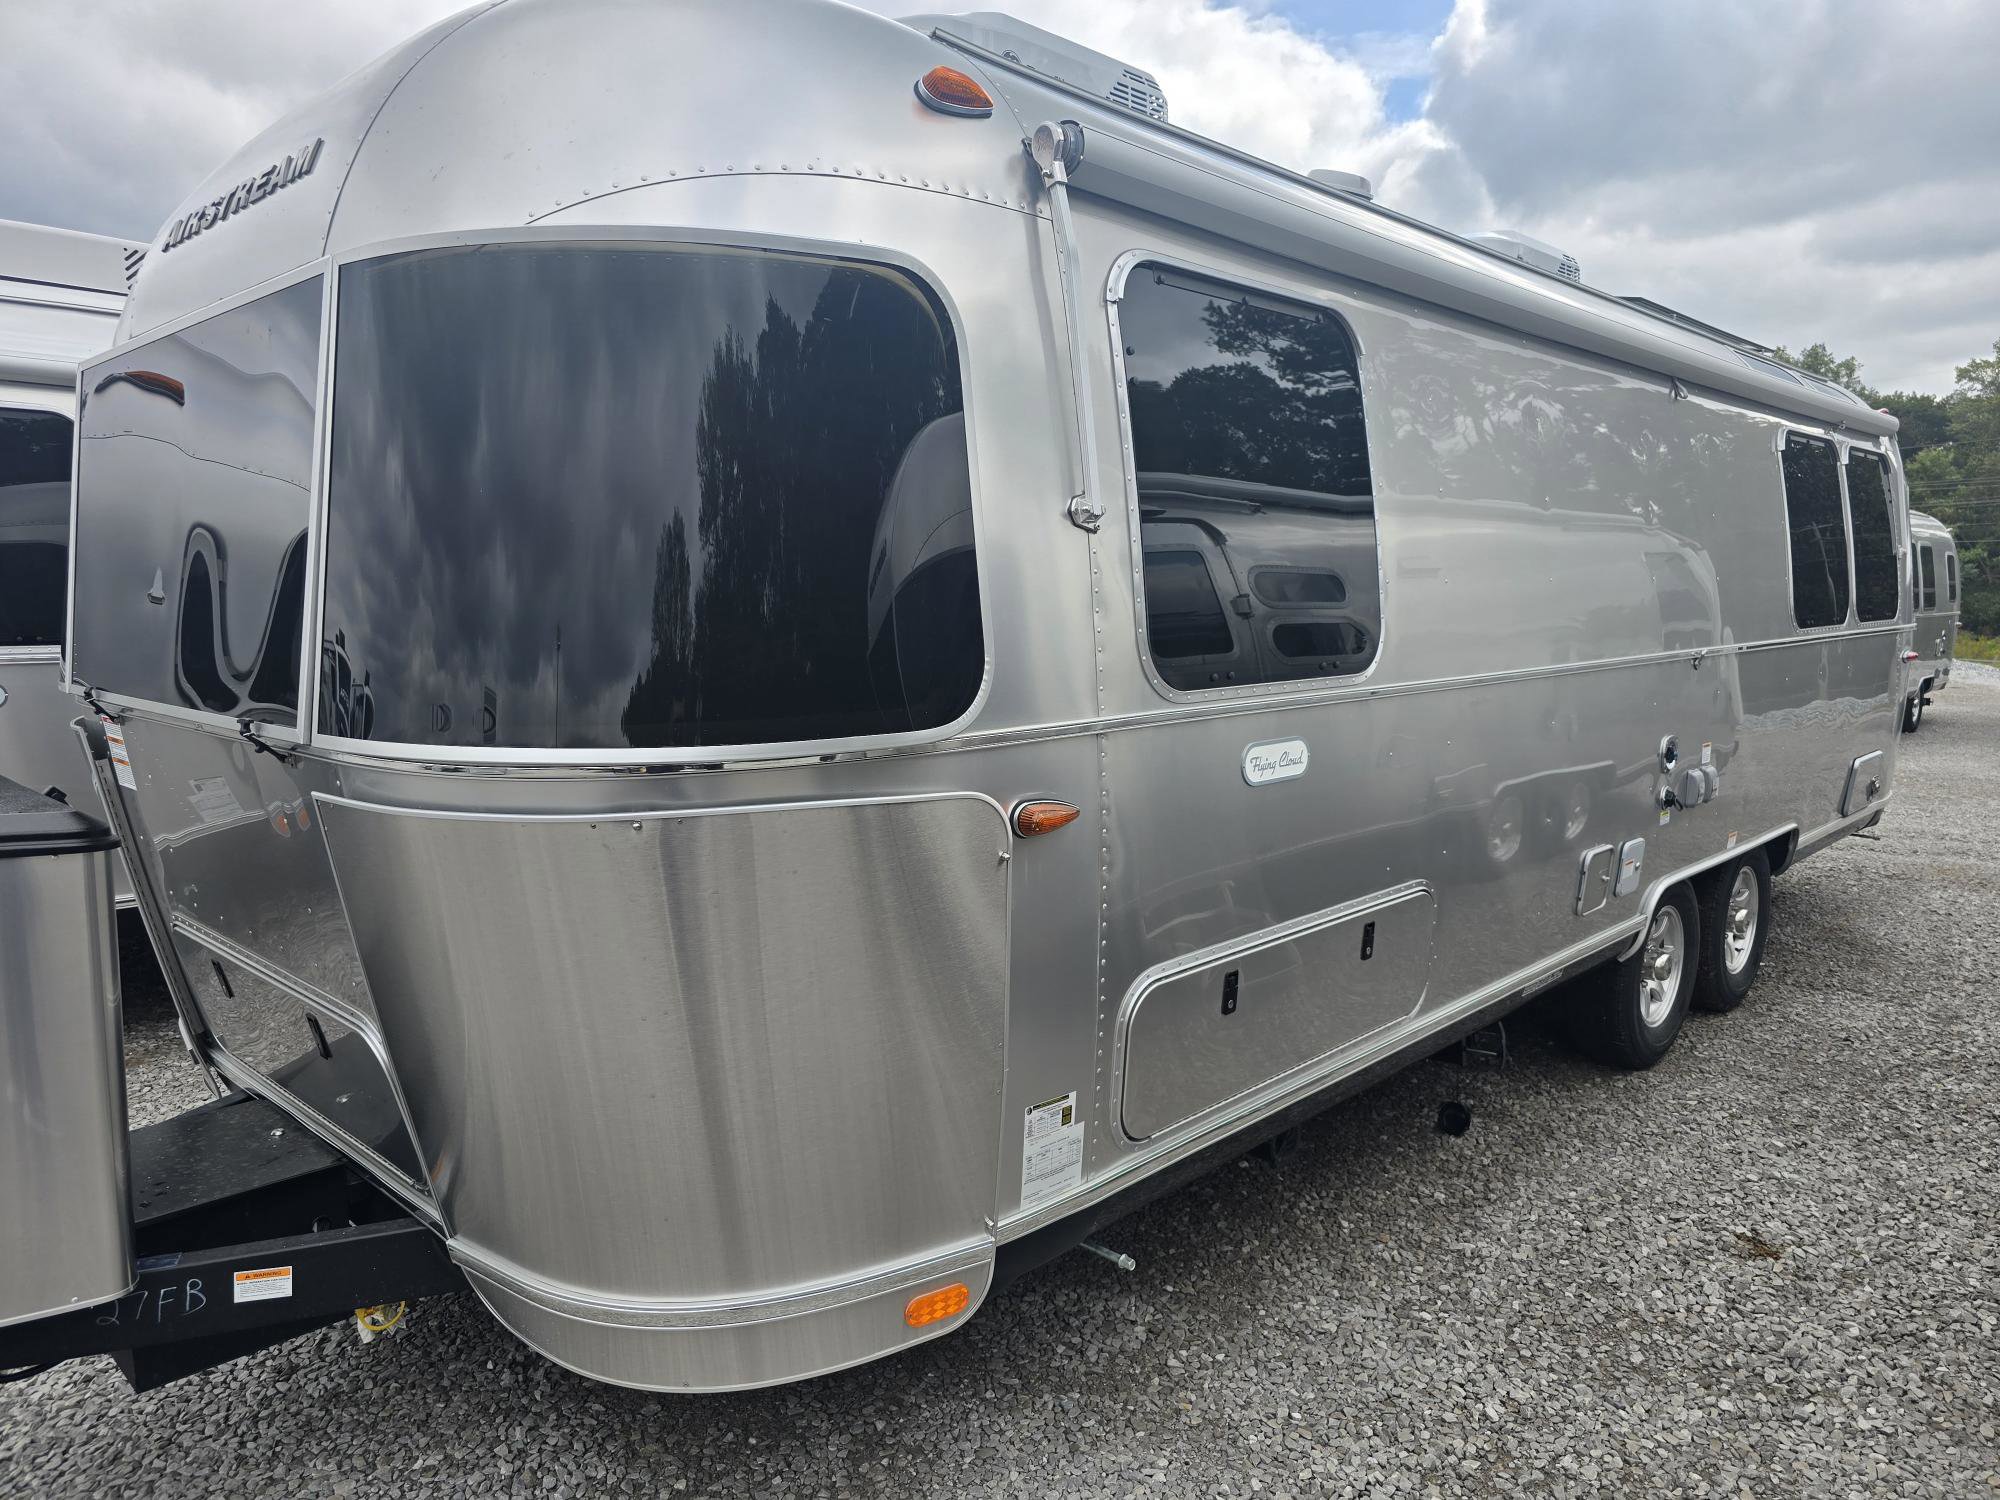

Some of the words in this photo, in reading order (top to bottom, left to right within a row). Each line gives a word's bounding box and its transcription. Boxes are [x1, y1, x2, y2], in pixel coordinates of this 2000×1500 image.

[162, 138, 324, 252] AIRSTREAM
[1250, 756, 1277, 778] Flying
[1279, 749, 1303, 767] Cloud
